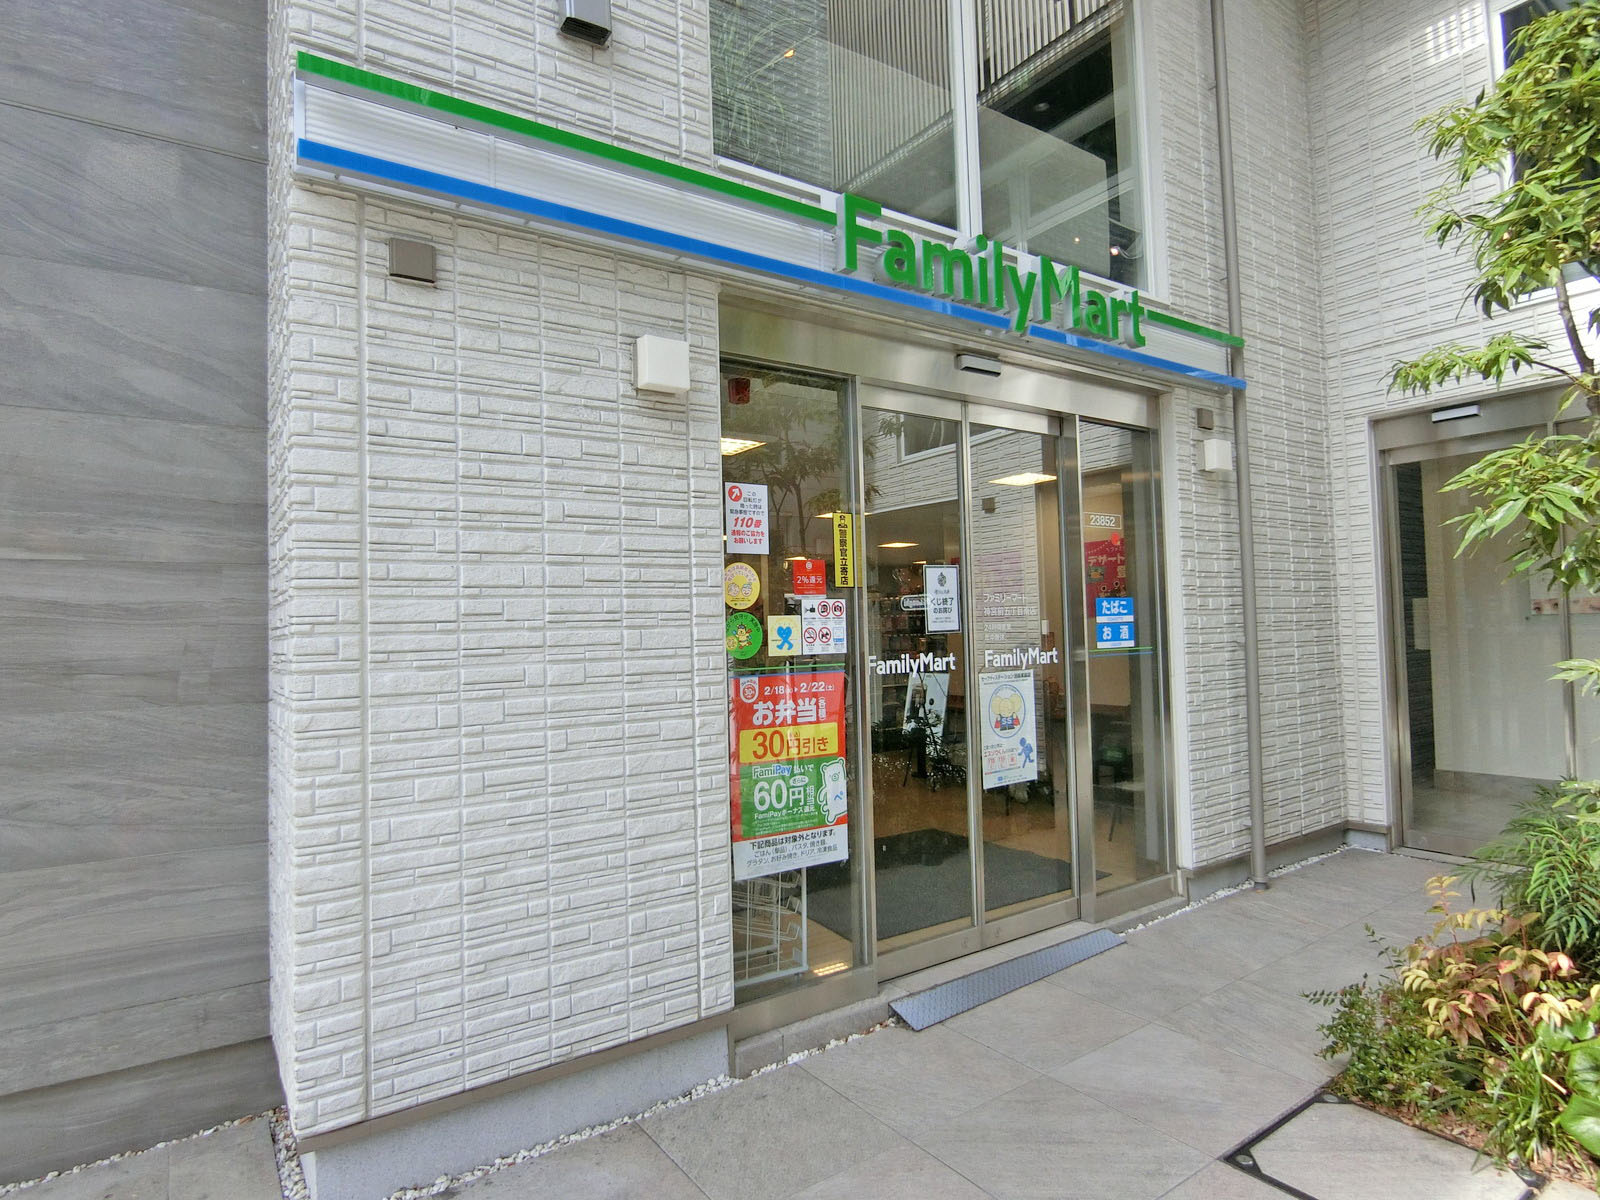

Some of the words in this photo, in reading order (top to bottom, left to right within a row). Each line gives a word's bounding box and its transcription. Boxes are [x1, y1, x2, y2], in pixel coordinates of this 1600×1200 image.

[836, 192, 1146, 348] FamilyMart
[734, 516, 762, 528] 110番
[1090, 514, 1116, 527] 23852
[838, 529, 848, 586] 警察官立寄店
[796, 575, 823, 584] 2%還元
[930, 598, 954, 606] くじ終了
[1102, 600, 1128, 614] たばこ
[868, 652, 956, 678] FamilyMart
[984, 647, 1058, 670] FamilyMart
[752, 697, 817, 726] お弁当
[752, 730, 829, 760] 30円引き
[753, 764, 792, 778] FamiPay
[754, 779, 805, 812] 60円
[750, 829, 836, 850] 下記商品は対象外となります。
